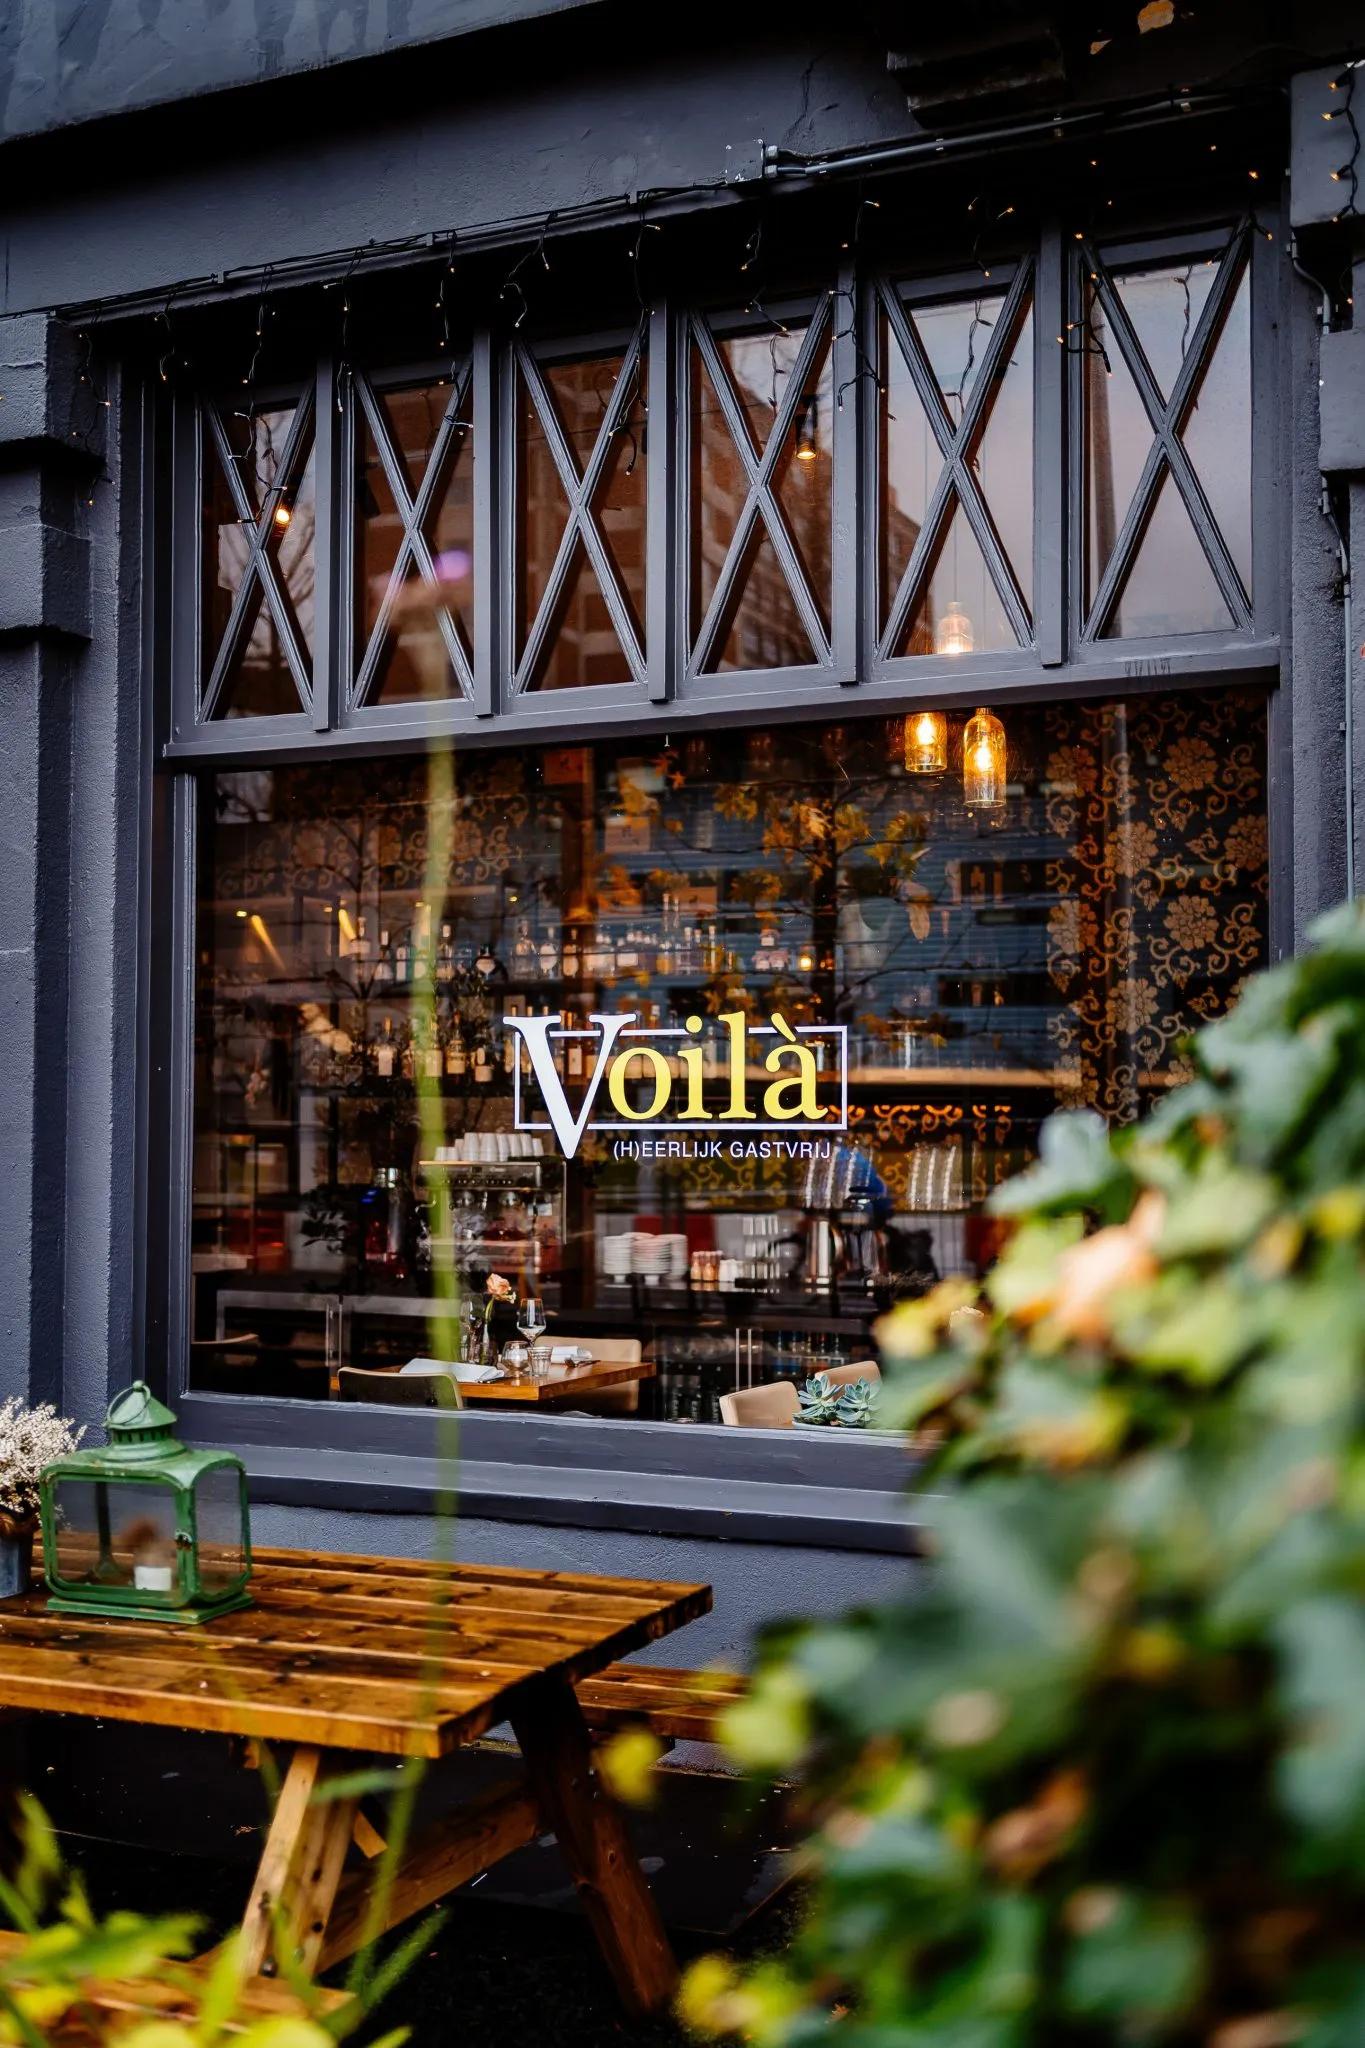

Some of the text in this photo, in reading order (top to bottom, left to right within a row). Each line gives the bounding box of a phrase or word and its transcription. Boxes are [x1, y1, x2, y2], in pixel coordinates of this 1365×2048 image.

[503, 1011, 828, 1158] Voilà
[613, 1141, 831, 1160] (H)EERLIJK GASTVRIJ
